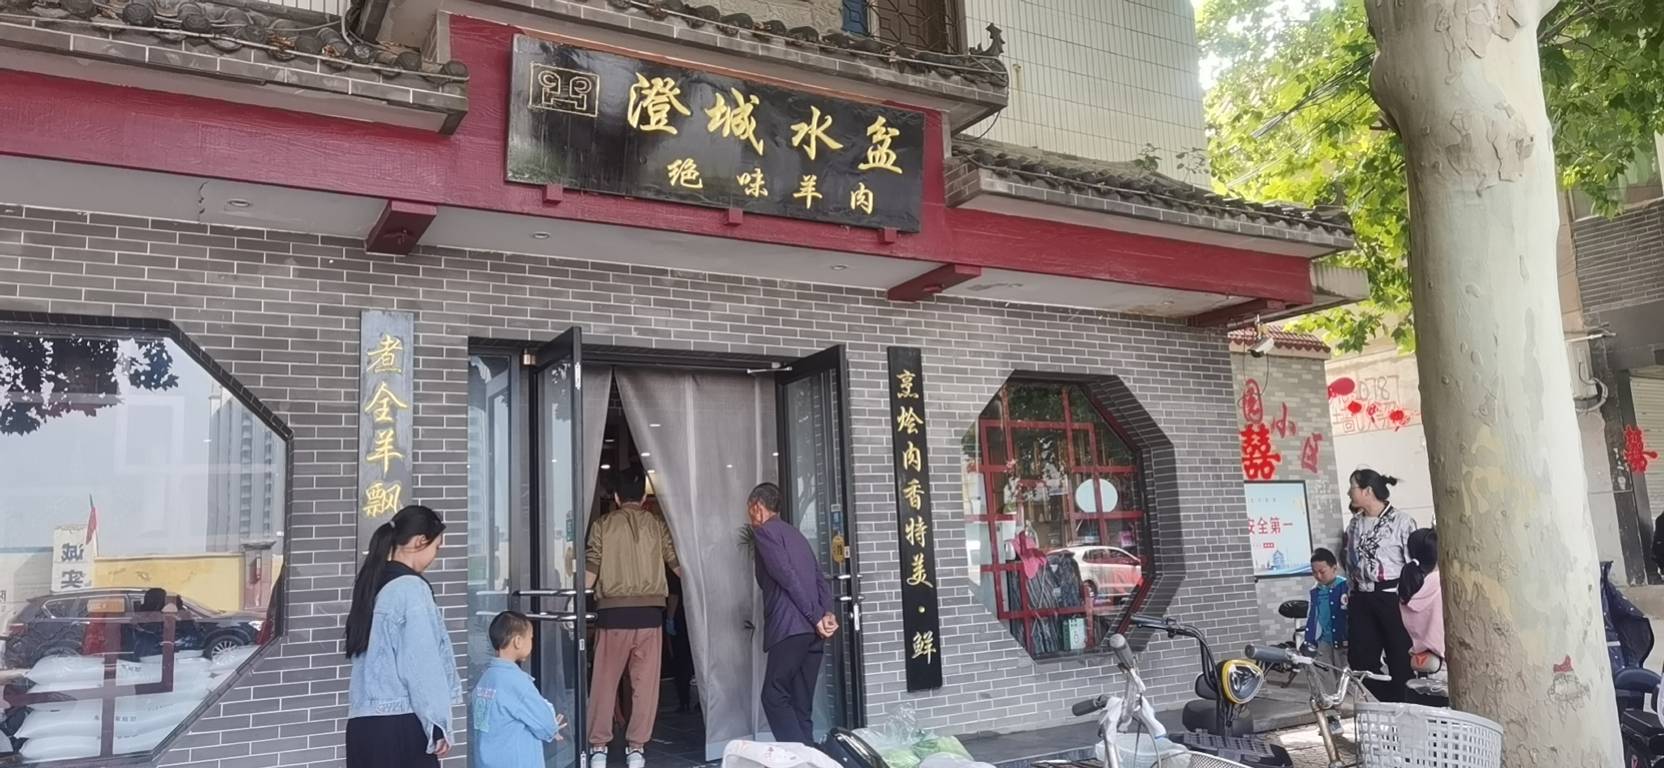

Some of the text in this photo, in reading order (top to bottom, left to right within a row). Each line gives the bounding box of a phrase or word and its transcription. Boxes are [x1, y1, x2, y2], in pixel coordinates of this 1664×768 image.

[627, 72, 903, 174] 澄城水盆
[666, 158, 874, 215] 绝味羊肉
[362, 335, 409, 566] 煮全羊飘
